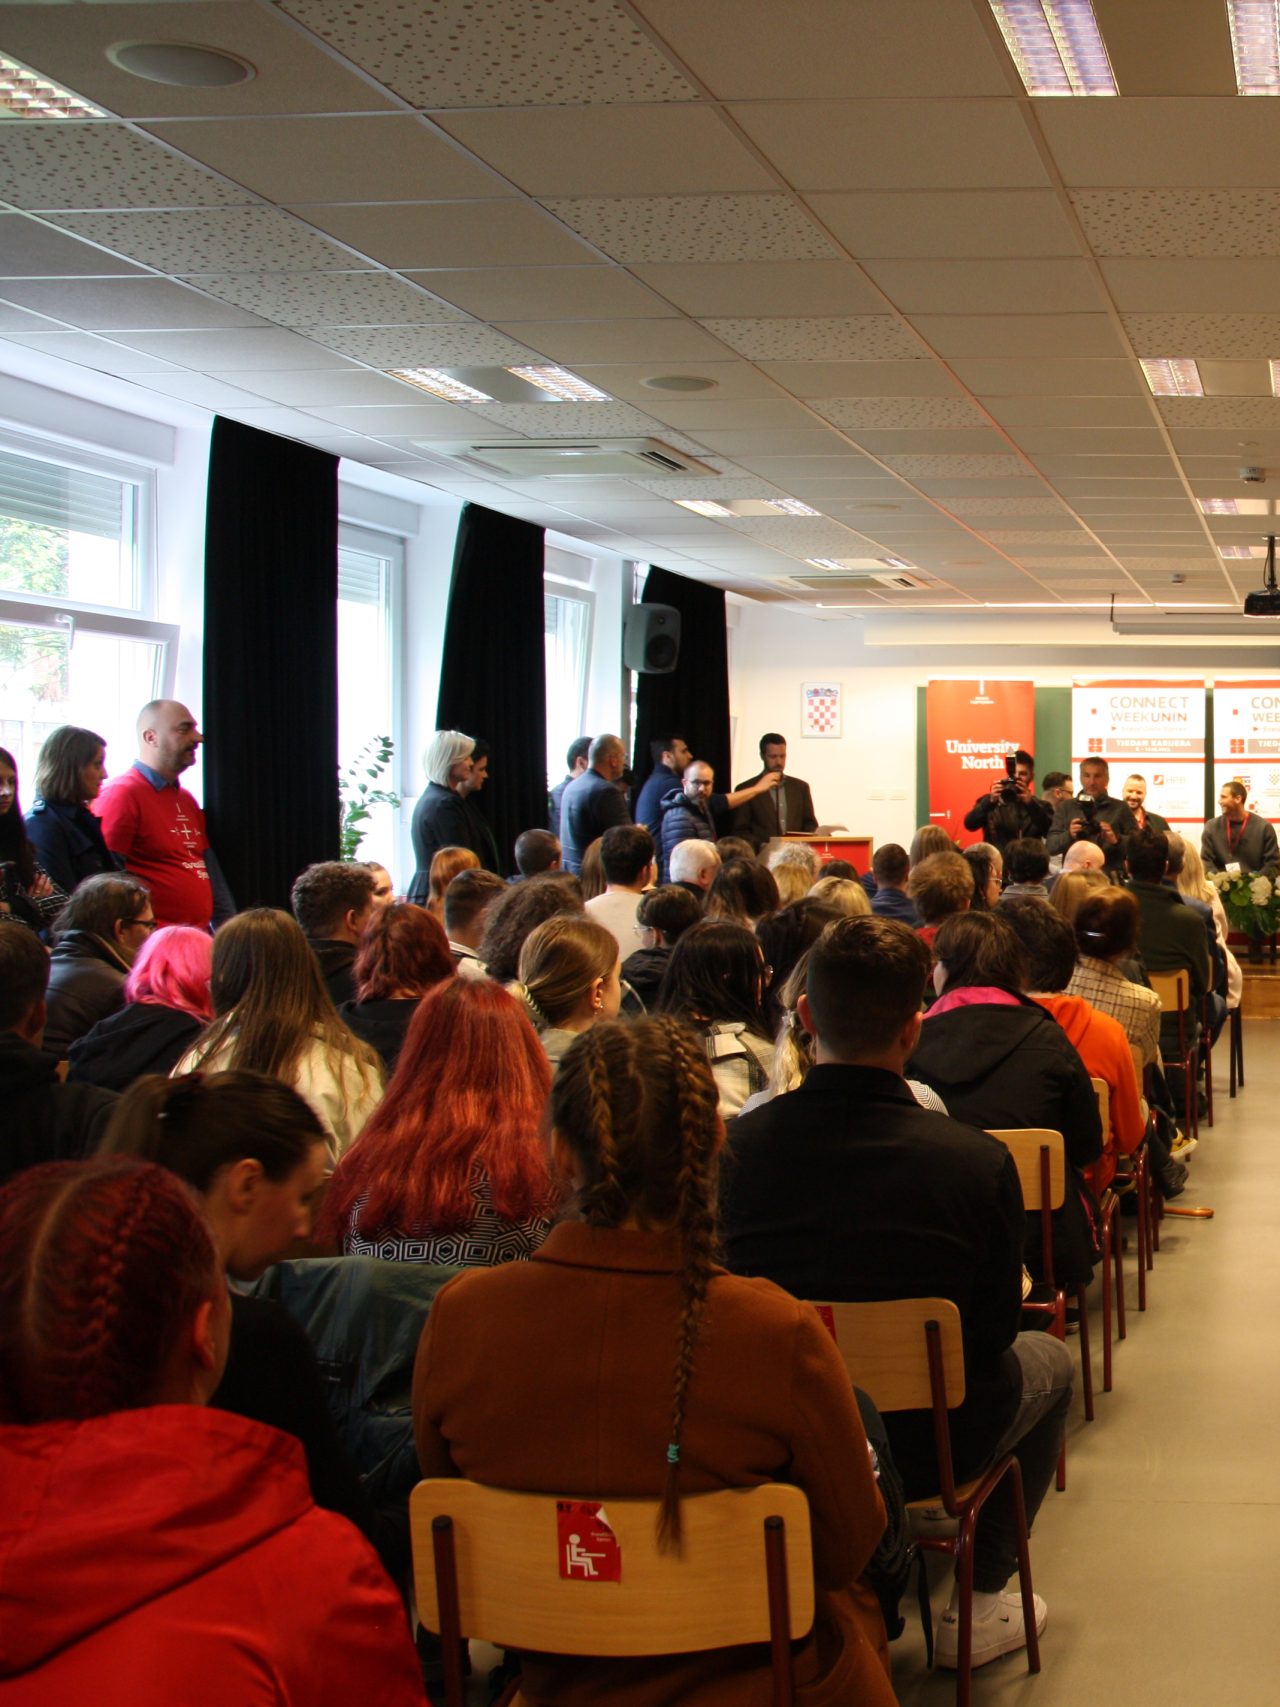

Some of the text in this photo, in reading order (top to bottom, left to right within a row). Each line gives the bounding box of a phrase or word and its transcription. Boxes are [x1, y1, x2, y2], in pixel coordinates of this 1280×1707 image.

[1110, 696, 1190, 709] CONNECT
[1111, 712, 1188, 722] WEEKUNIN
[945, 739, 1020, 754] University
[961, 754, 1005, 769] North
